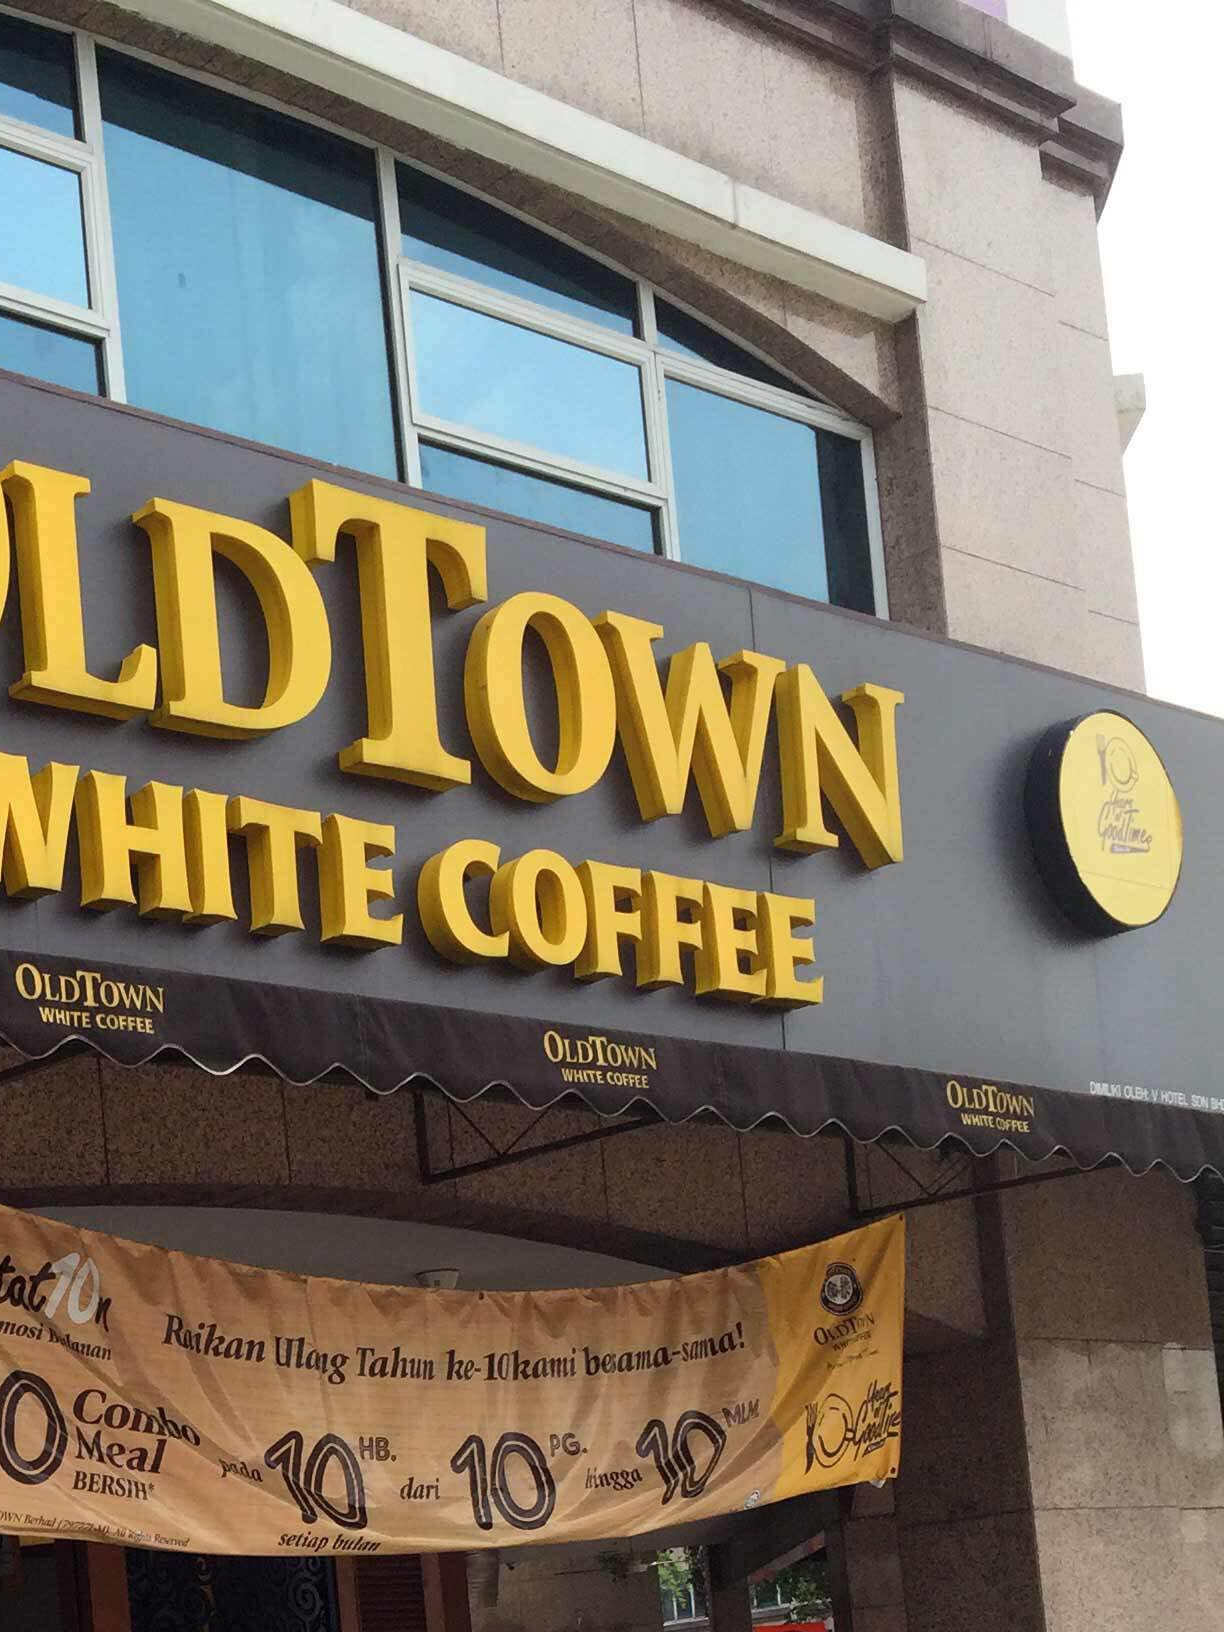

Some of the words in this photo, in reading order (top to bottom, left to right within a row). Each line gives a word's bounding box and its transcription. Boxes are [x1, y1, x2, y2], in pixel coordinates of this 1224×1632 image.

[417, 838, 824, 1008] COFFEE
[15, 963, 166, 1013] OLDTOWN
[39, 1006, 92, 1028] WHITE
[96, 1014, 155, 1034] COFFEE
[543, 1030, 657, 1070] OLDTOWN
[561, 1068, 604, 1084] WHITE
[606, 1071, 649, 1089] COFFEE
[946, 1080, 1034, 1117] OLDTOWN
[1161, 1090, 1188, 1106] HOTEL
[1191, 1094, 1208, 1109] SDN
[961, 1113, 995, 1128] WHITE
[996, 1117, 1030, 1133] COFFEE
[161, 1313, 266, 1363] Raikan
[355, 1346, 435, 1381] Tahun
[73, 1388, 201, 1447] Combo
[74, 1427, 168, 1474] Meal
[219, 1457, 264, 1483] pada
[264, 1430, 368, 1530] 10
[358, 1436, 397, 1462] HB.
[399, 1476, 440, 1501] dari
[450, 1431, 556, 1531] 10
[549, 1432, 587, 1457] PG.
[585, 1466, 643, 1492] hingga
[636, 1409, 727, 1506] 10
[277, 1531, 329, 1553] setiap
[332, 1533, 383, 1552] bulan
